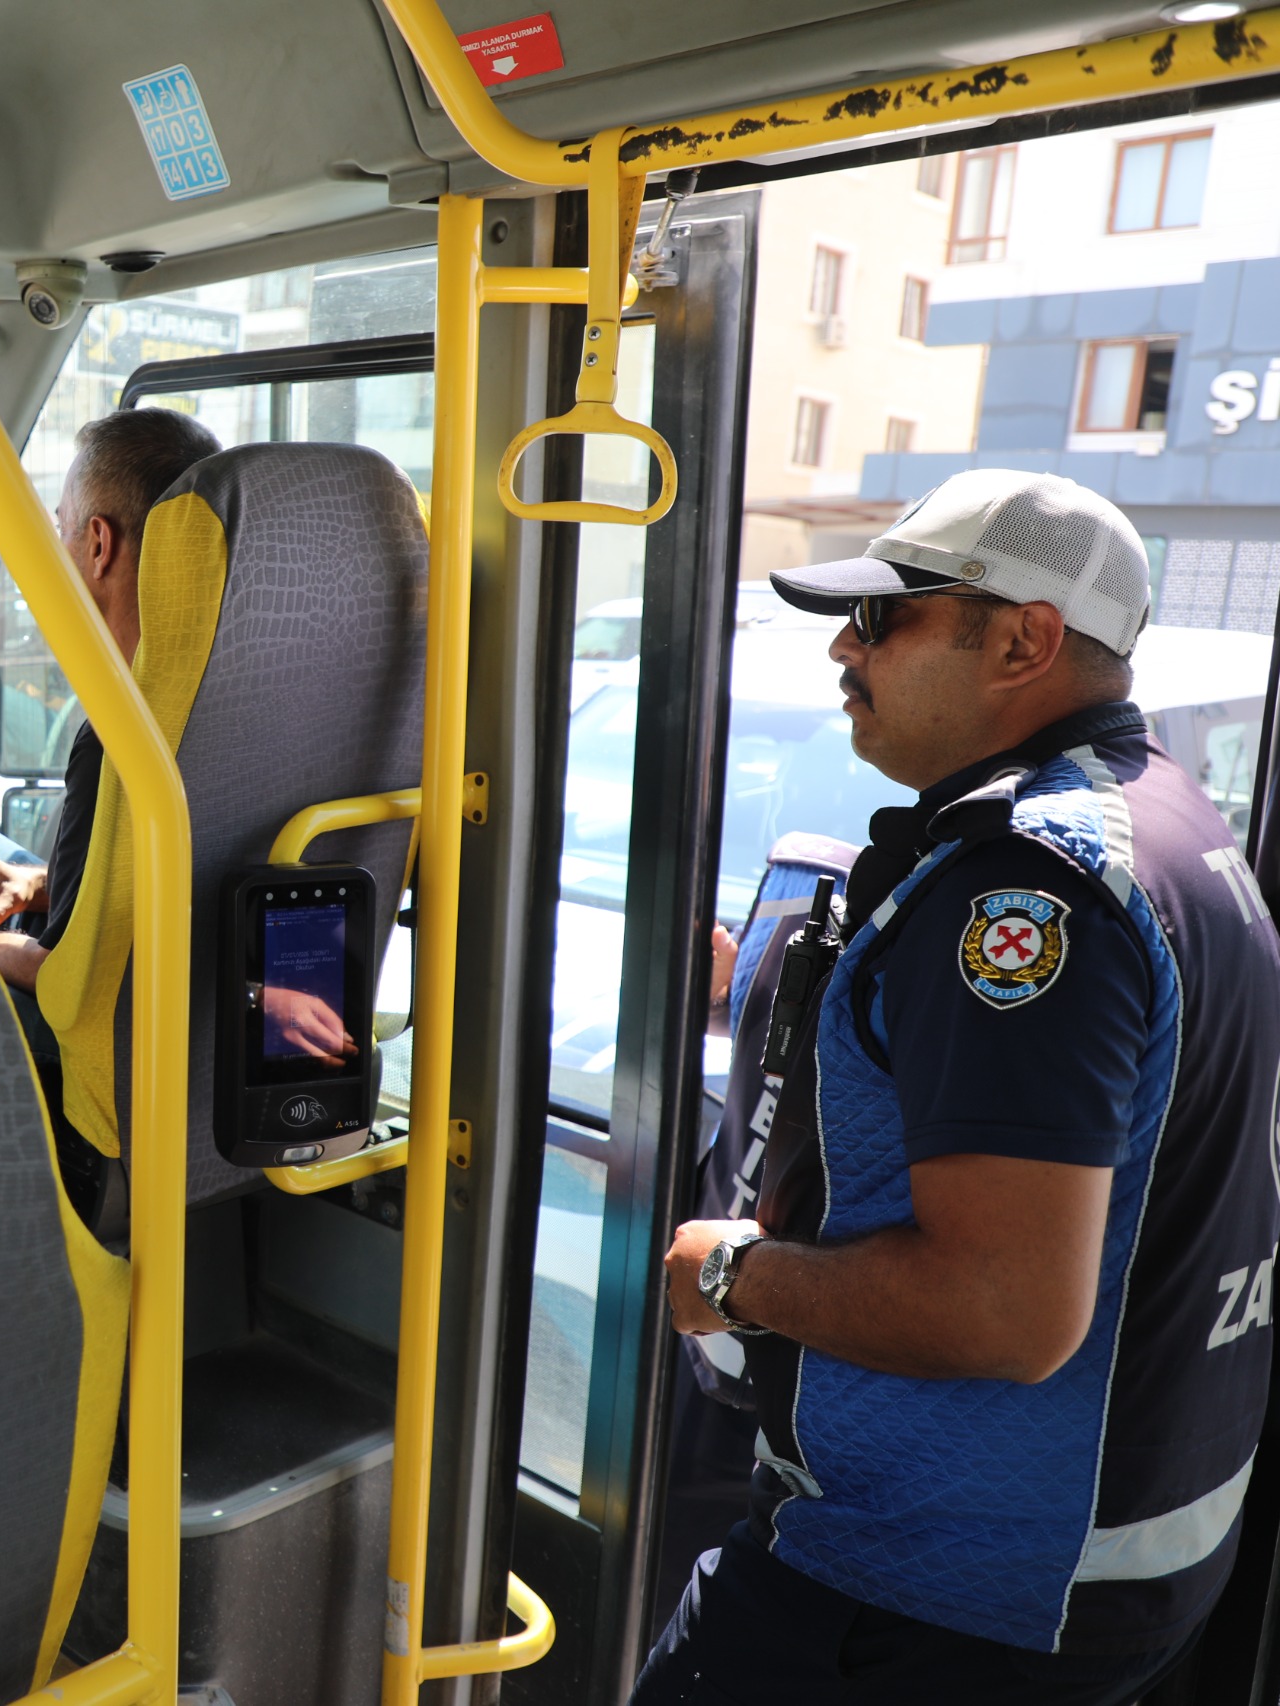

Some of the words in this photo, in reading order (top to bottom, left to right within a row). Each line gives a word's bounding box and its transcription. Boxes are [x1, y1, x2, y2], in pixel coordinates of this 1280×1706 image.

[481, 34, 511, 48] ALANDA
[511, 25, 543, 40] DURMAK
[170, 121, 185, 146] 0
[188, 115, 205, 141] 3
[184, 157, 199, 182] 1
[201, 151, 218, 178] 3
[992, 896, 1045, 914] ZABITA
[1207, 1242, 1278, 1351] ZA
